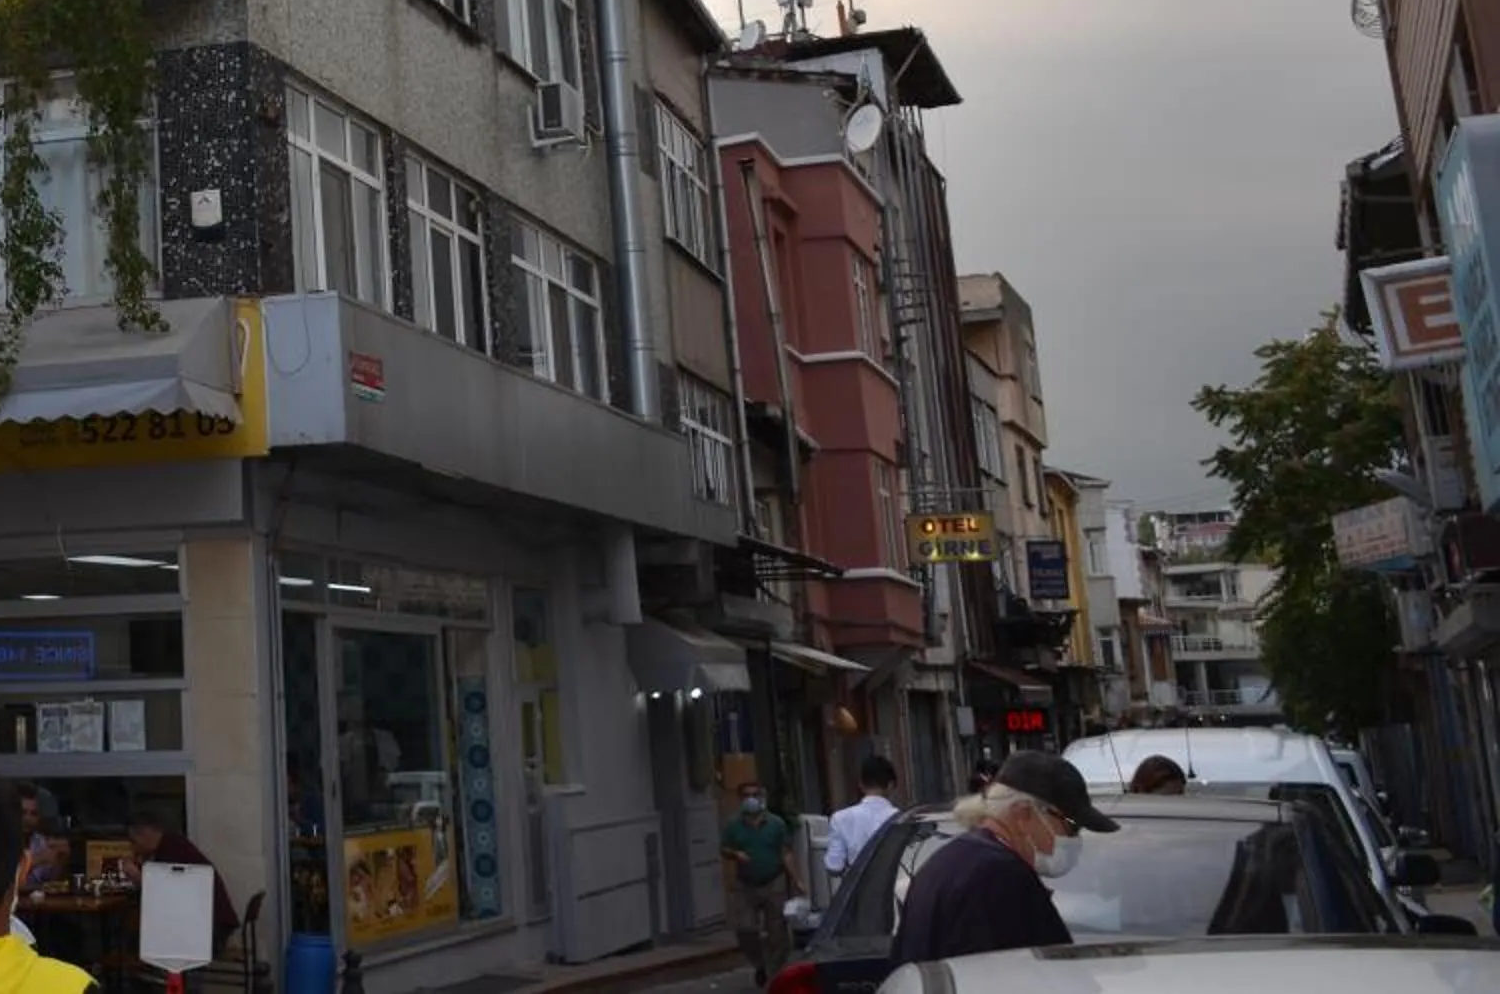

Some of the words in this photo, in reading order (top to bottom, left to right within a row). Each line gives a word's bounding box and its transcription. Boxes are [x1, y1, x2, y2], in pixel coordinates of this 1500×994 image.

[80, 413, 138, 444] 522
[149, 409, 186, 441] 81
[921, 517, 980, 534] OTEL
